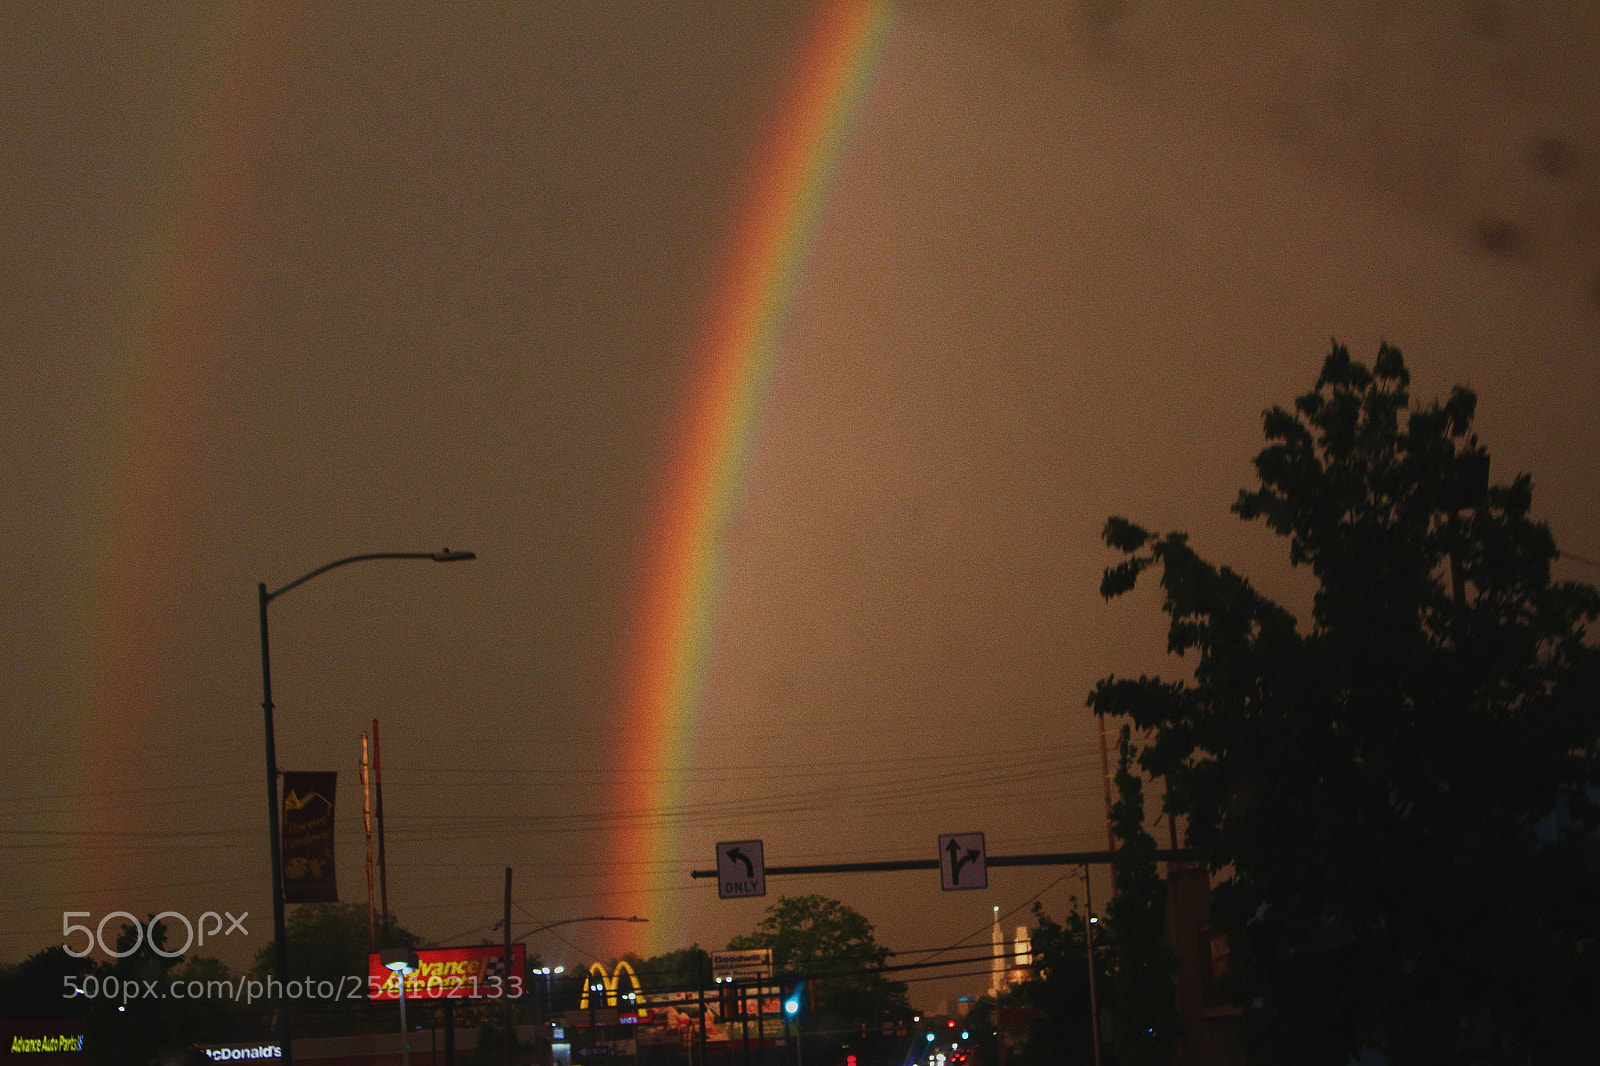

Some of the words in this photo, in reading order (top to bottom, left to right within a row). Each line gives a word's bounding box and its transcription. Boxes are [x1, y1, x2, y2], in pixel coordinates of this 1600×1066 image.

[725, 881, 758, 894] ONLY
[388, 959, 480, 978] dvance
[11, 1035, 41, 1053] Advance
[42, 1035, 58, 1052] Auto
[59, 1034, 78, 1052] Parts
